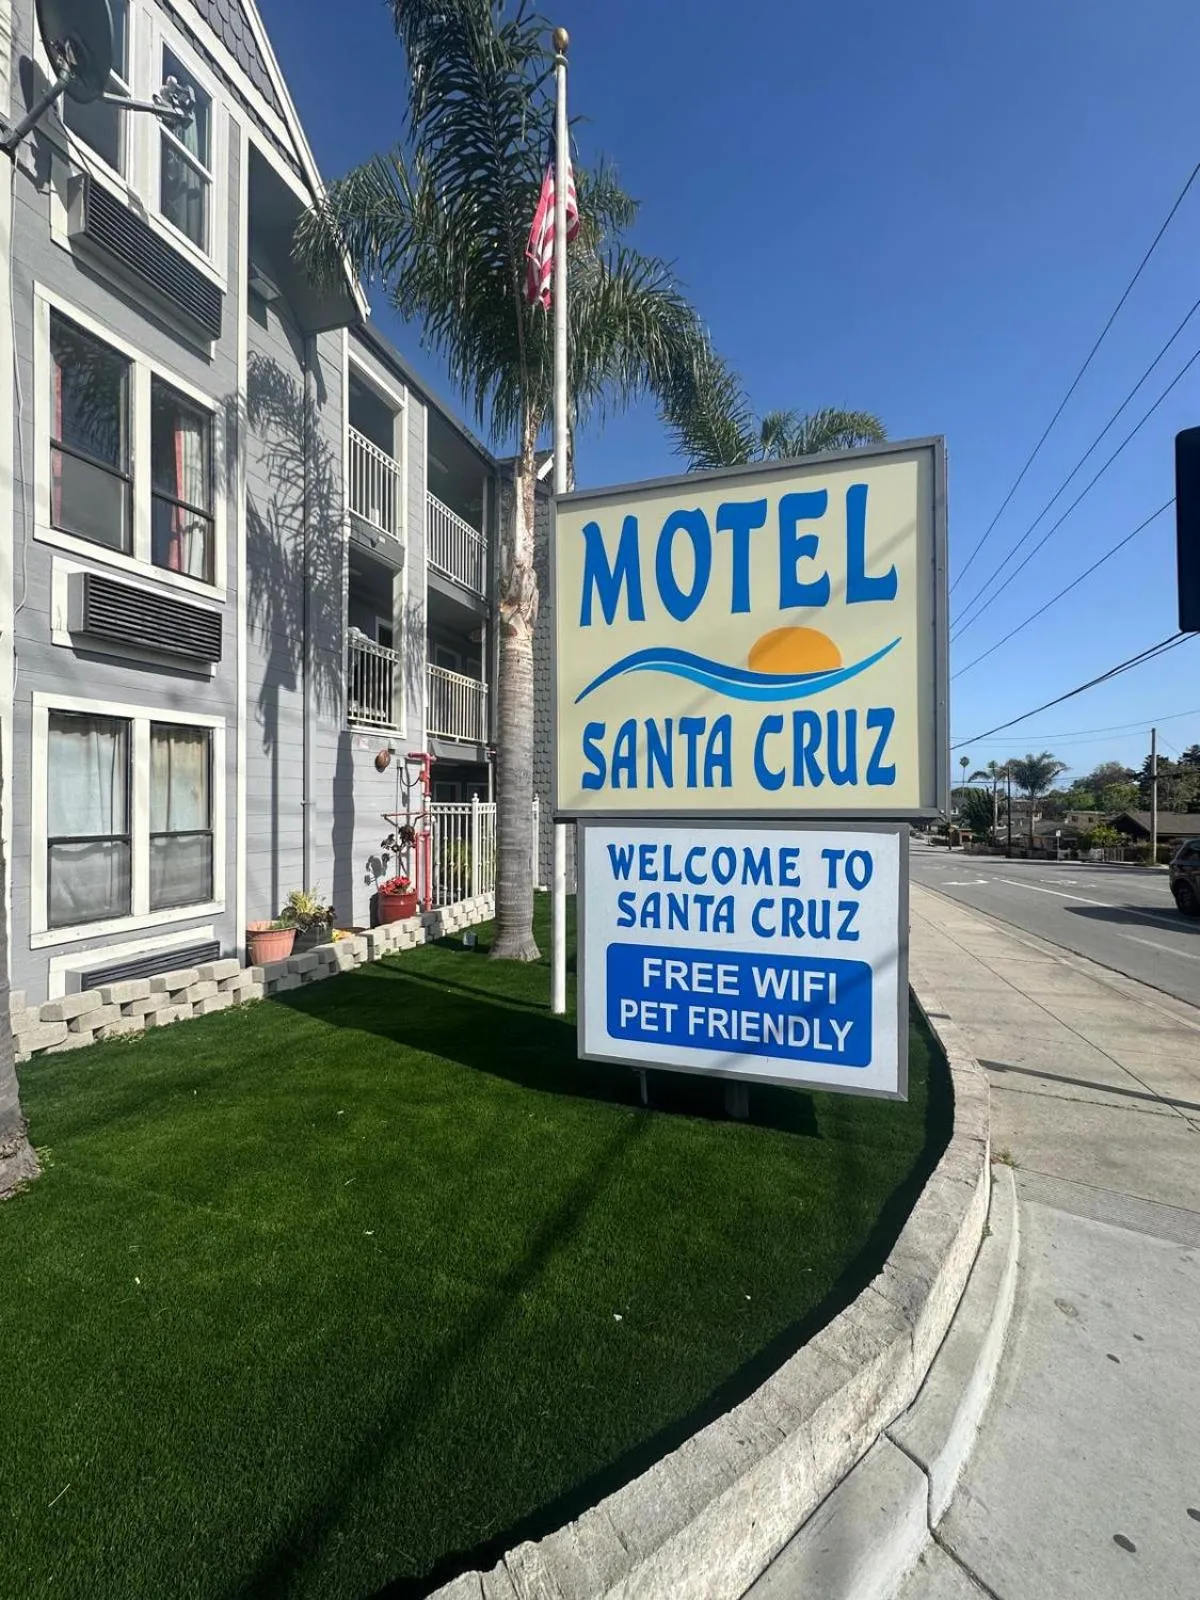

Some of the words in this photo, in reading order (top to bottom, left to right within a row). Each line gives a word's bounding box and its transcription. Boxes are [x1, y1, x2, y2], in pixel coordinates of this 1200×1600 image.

[580, 483, 898, 626] MOTEL
[581, 714, 732, 791] SANTA
[754, 706, 896, 791] CRUZ
[607, 844, 800, 886] WELCOME
[821, 848, 873, 890] TO
[616, 891, 735, 931] SANTA
[751, 897, 859, 939] CRUZ
[642, 957, 740, 994] FREE
[752, 967, 837, 1003] WIFI
[620, 999, 679, 1031] PET
[688, 1006, 854, 1051] FRIENDLY
